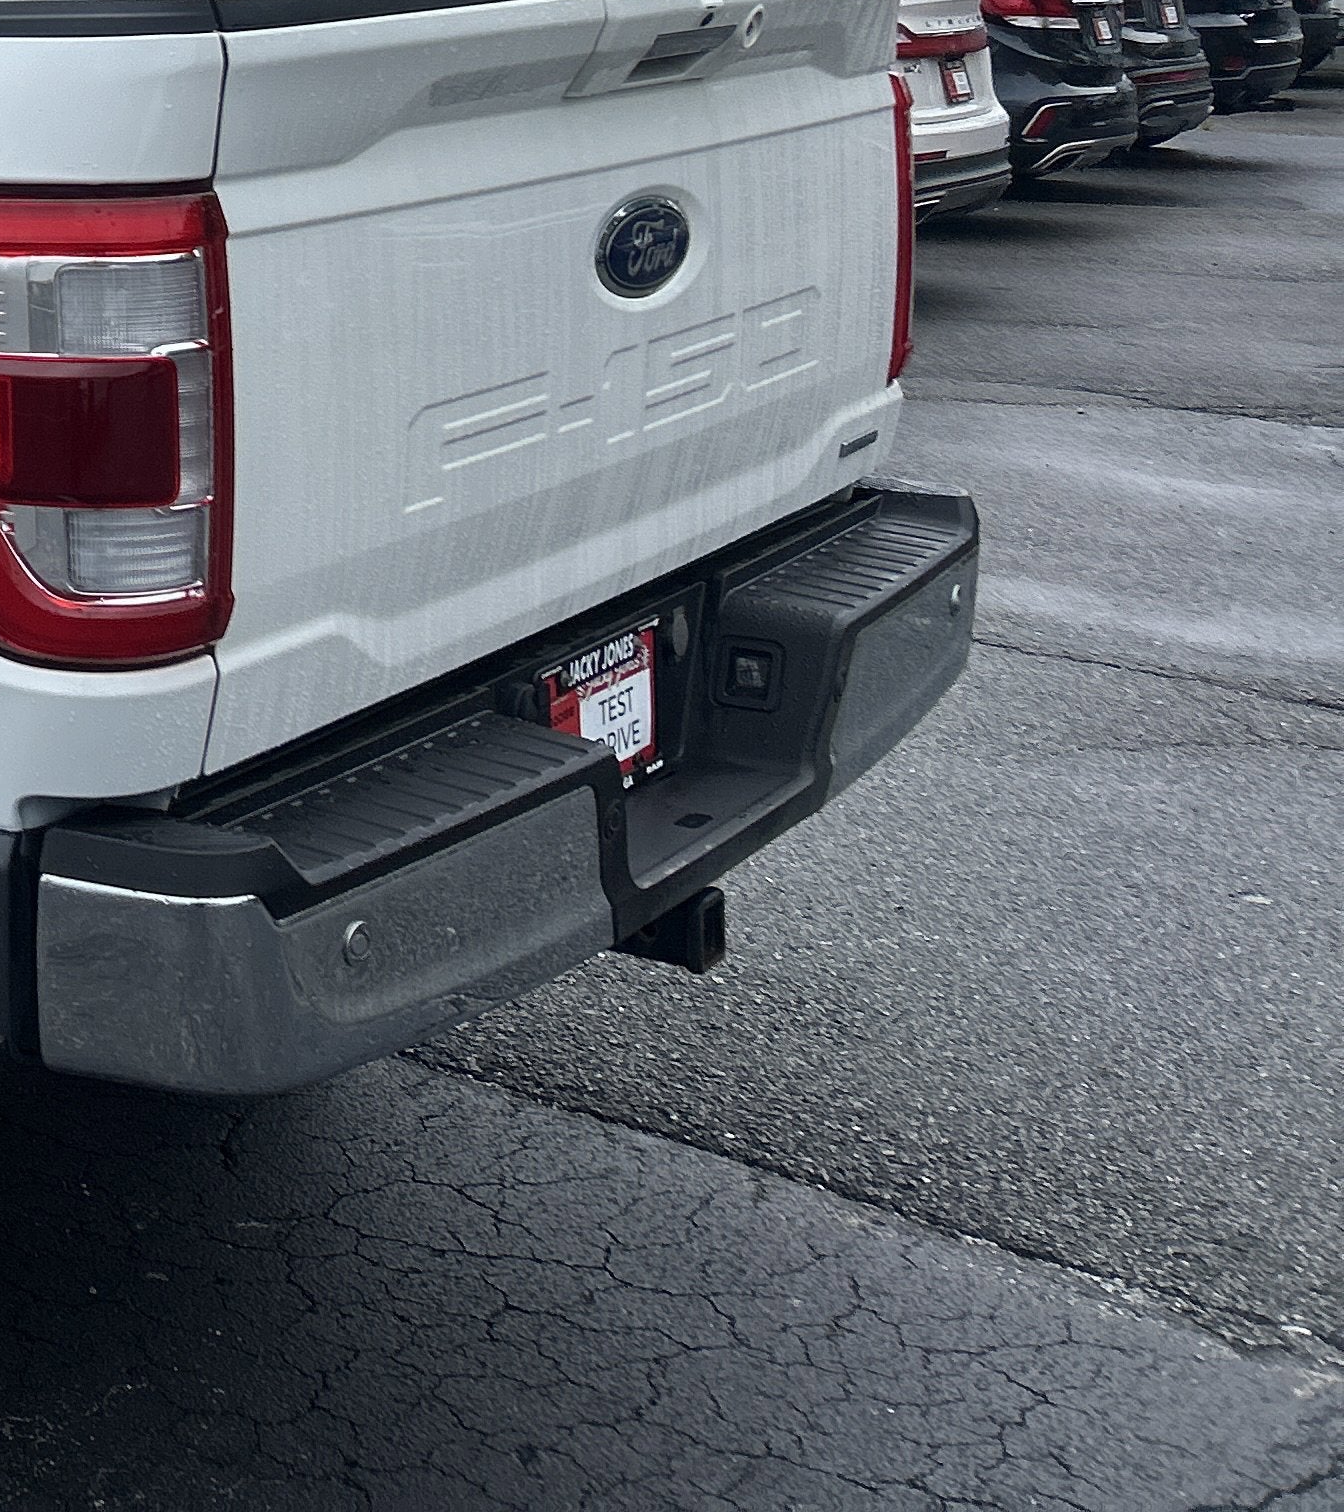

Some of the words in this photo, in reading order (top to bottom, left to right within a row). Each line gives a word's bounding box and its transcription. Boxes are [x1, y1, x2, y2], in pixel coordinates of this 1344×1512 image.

[627, 218, 678, 278] Ford
[567, 648, 601, 687] JACKY
[601, 632, 635, 670] JONES
[598, 685, 634, 726] TEST
